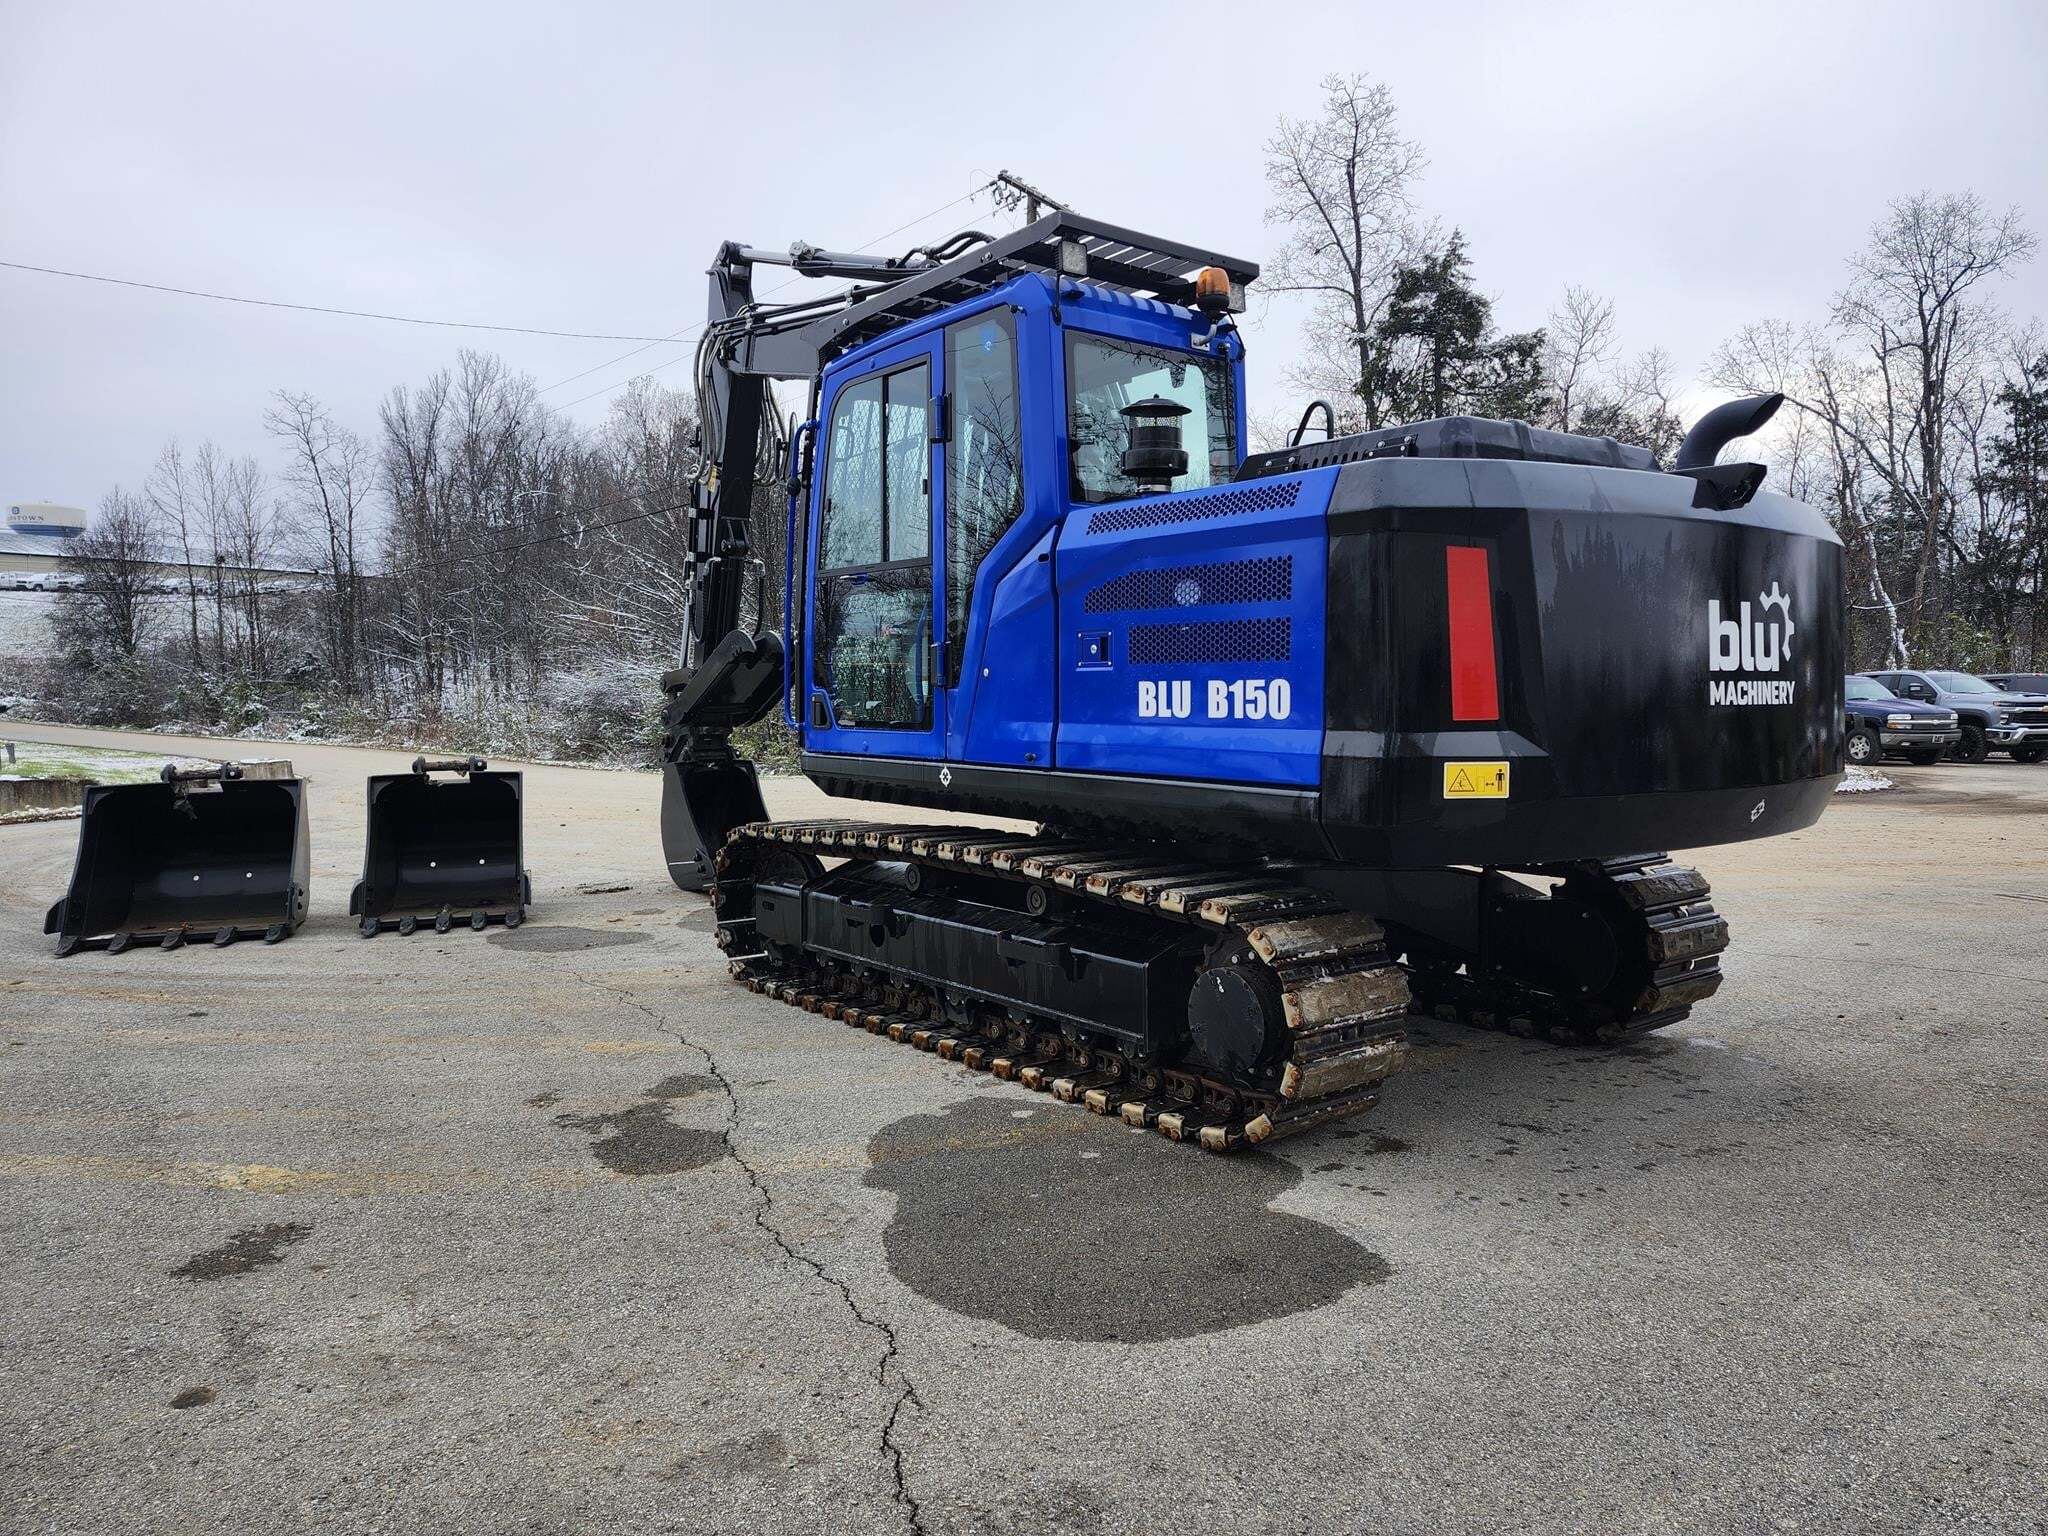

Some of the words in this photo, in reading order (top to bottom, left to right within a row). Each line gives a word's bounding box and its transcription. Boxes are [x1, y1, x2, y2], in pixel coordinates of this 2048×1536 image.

[1708, 599, 1780, 672] blu
[1138, 680, 1192, 718] BLU
[1207, 678, 1291, 720] B150
[1709, 680, 1796, 706] MACHINERY
